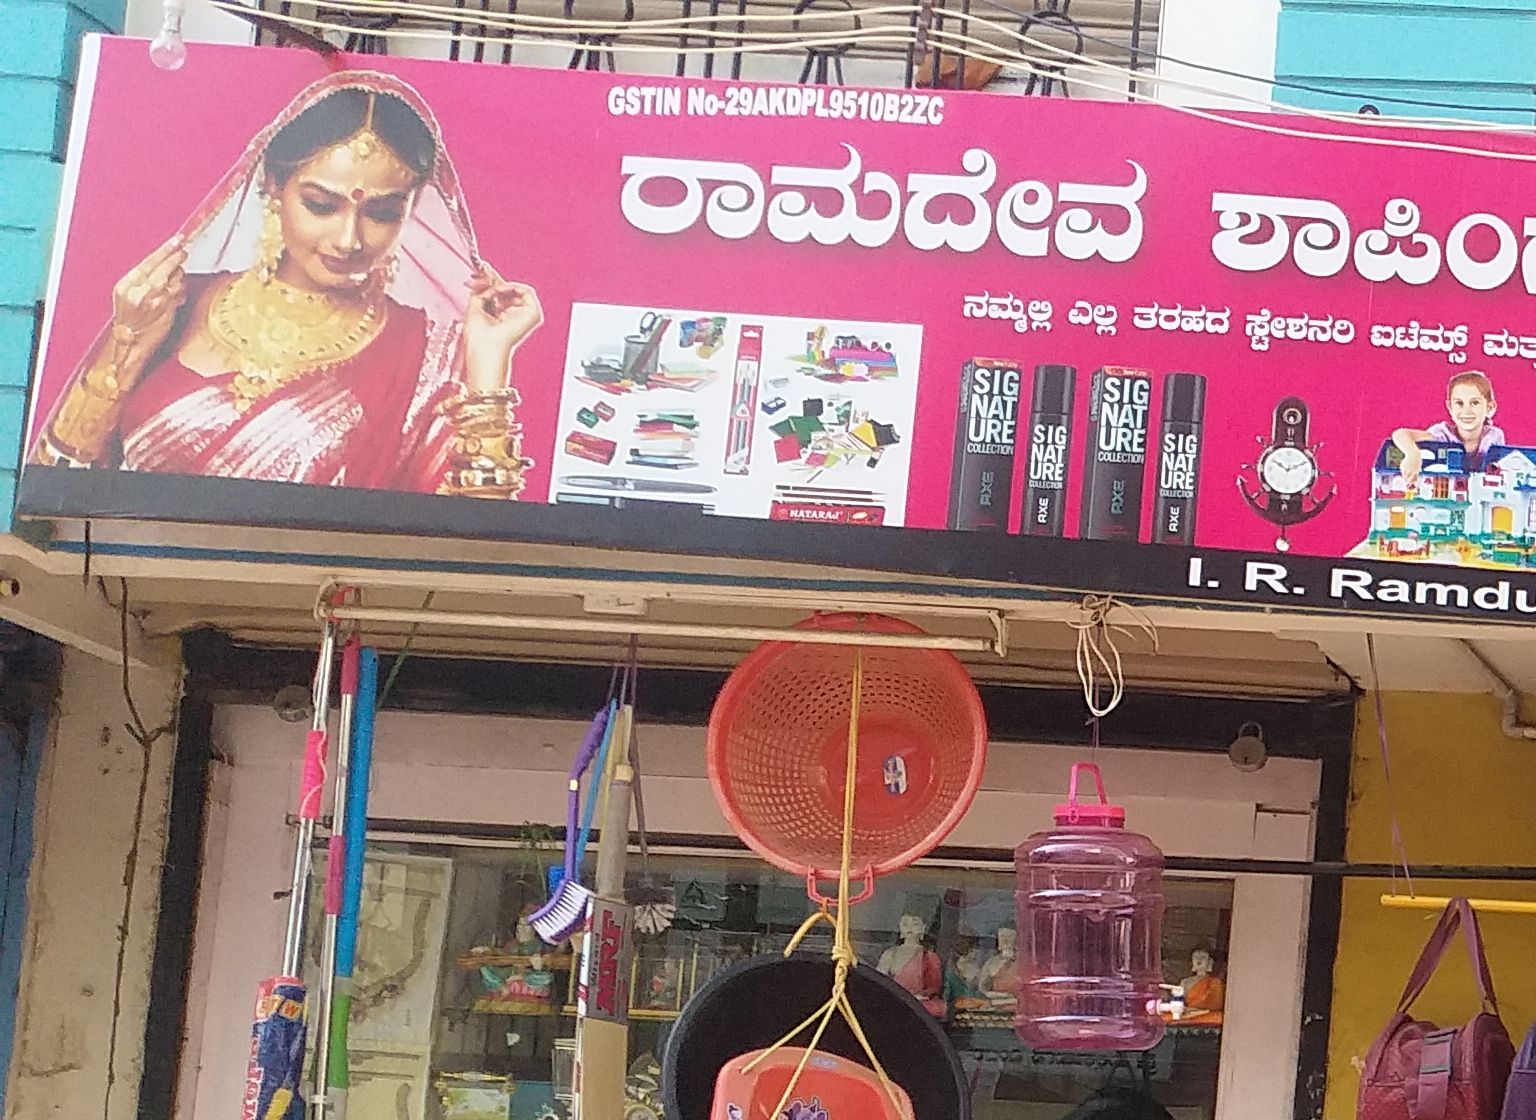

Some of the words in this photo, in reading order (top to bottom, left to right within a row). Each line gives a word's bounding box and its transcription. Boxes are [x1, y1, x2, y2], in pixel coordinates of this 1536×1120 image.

[607, 86, 681, 115] GSTIN
[620, 142, 1148, 263] ರಾಮದೇವ
[963, 290, 1053, 333] ನಮ್ಮಲ್ಲಿ
[1068, 300, 1118, 336] ಎಲ್ಲ
[1133, 302, 1231, 334] ತರಹದ
[973, 369, 1020, 394] SIG
[1103, 378, 1149, 403] SIG
[971, 395, 1016, 421] NAT
[1101, 404, 1147, 429] NAT
[969, 419, 1015, 444] URE
[1033, 425, 1067, 445] SIG
[1099, 427, 1145, 452] URE
[1163, 434, 1197, 453] SIG
[967, 444, 1014, 456] COLLECTION
[1031, 445, 1066, 465] NAT
[1097, 452, 1144, 464] COLLECTION
[1030, 462, 1064, 481] URE
[1162, 453, 1196, 473] NAT
[1160, 471, 1194, 490] URE
[788, 508, 842, 522] NATARAJ
[1037, 497, 1049, 524] AXE
[1168, 507, 1180, 533] AXE
[1188, 557, 1219, 588] I.
[1239, 561, 1305, 595] R.
